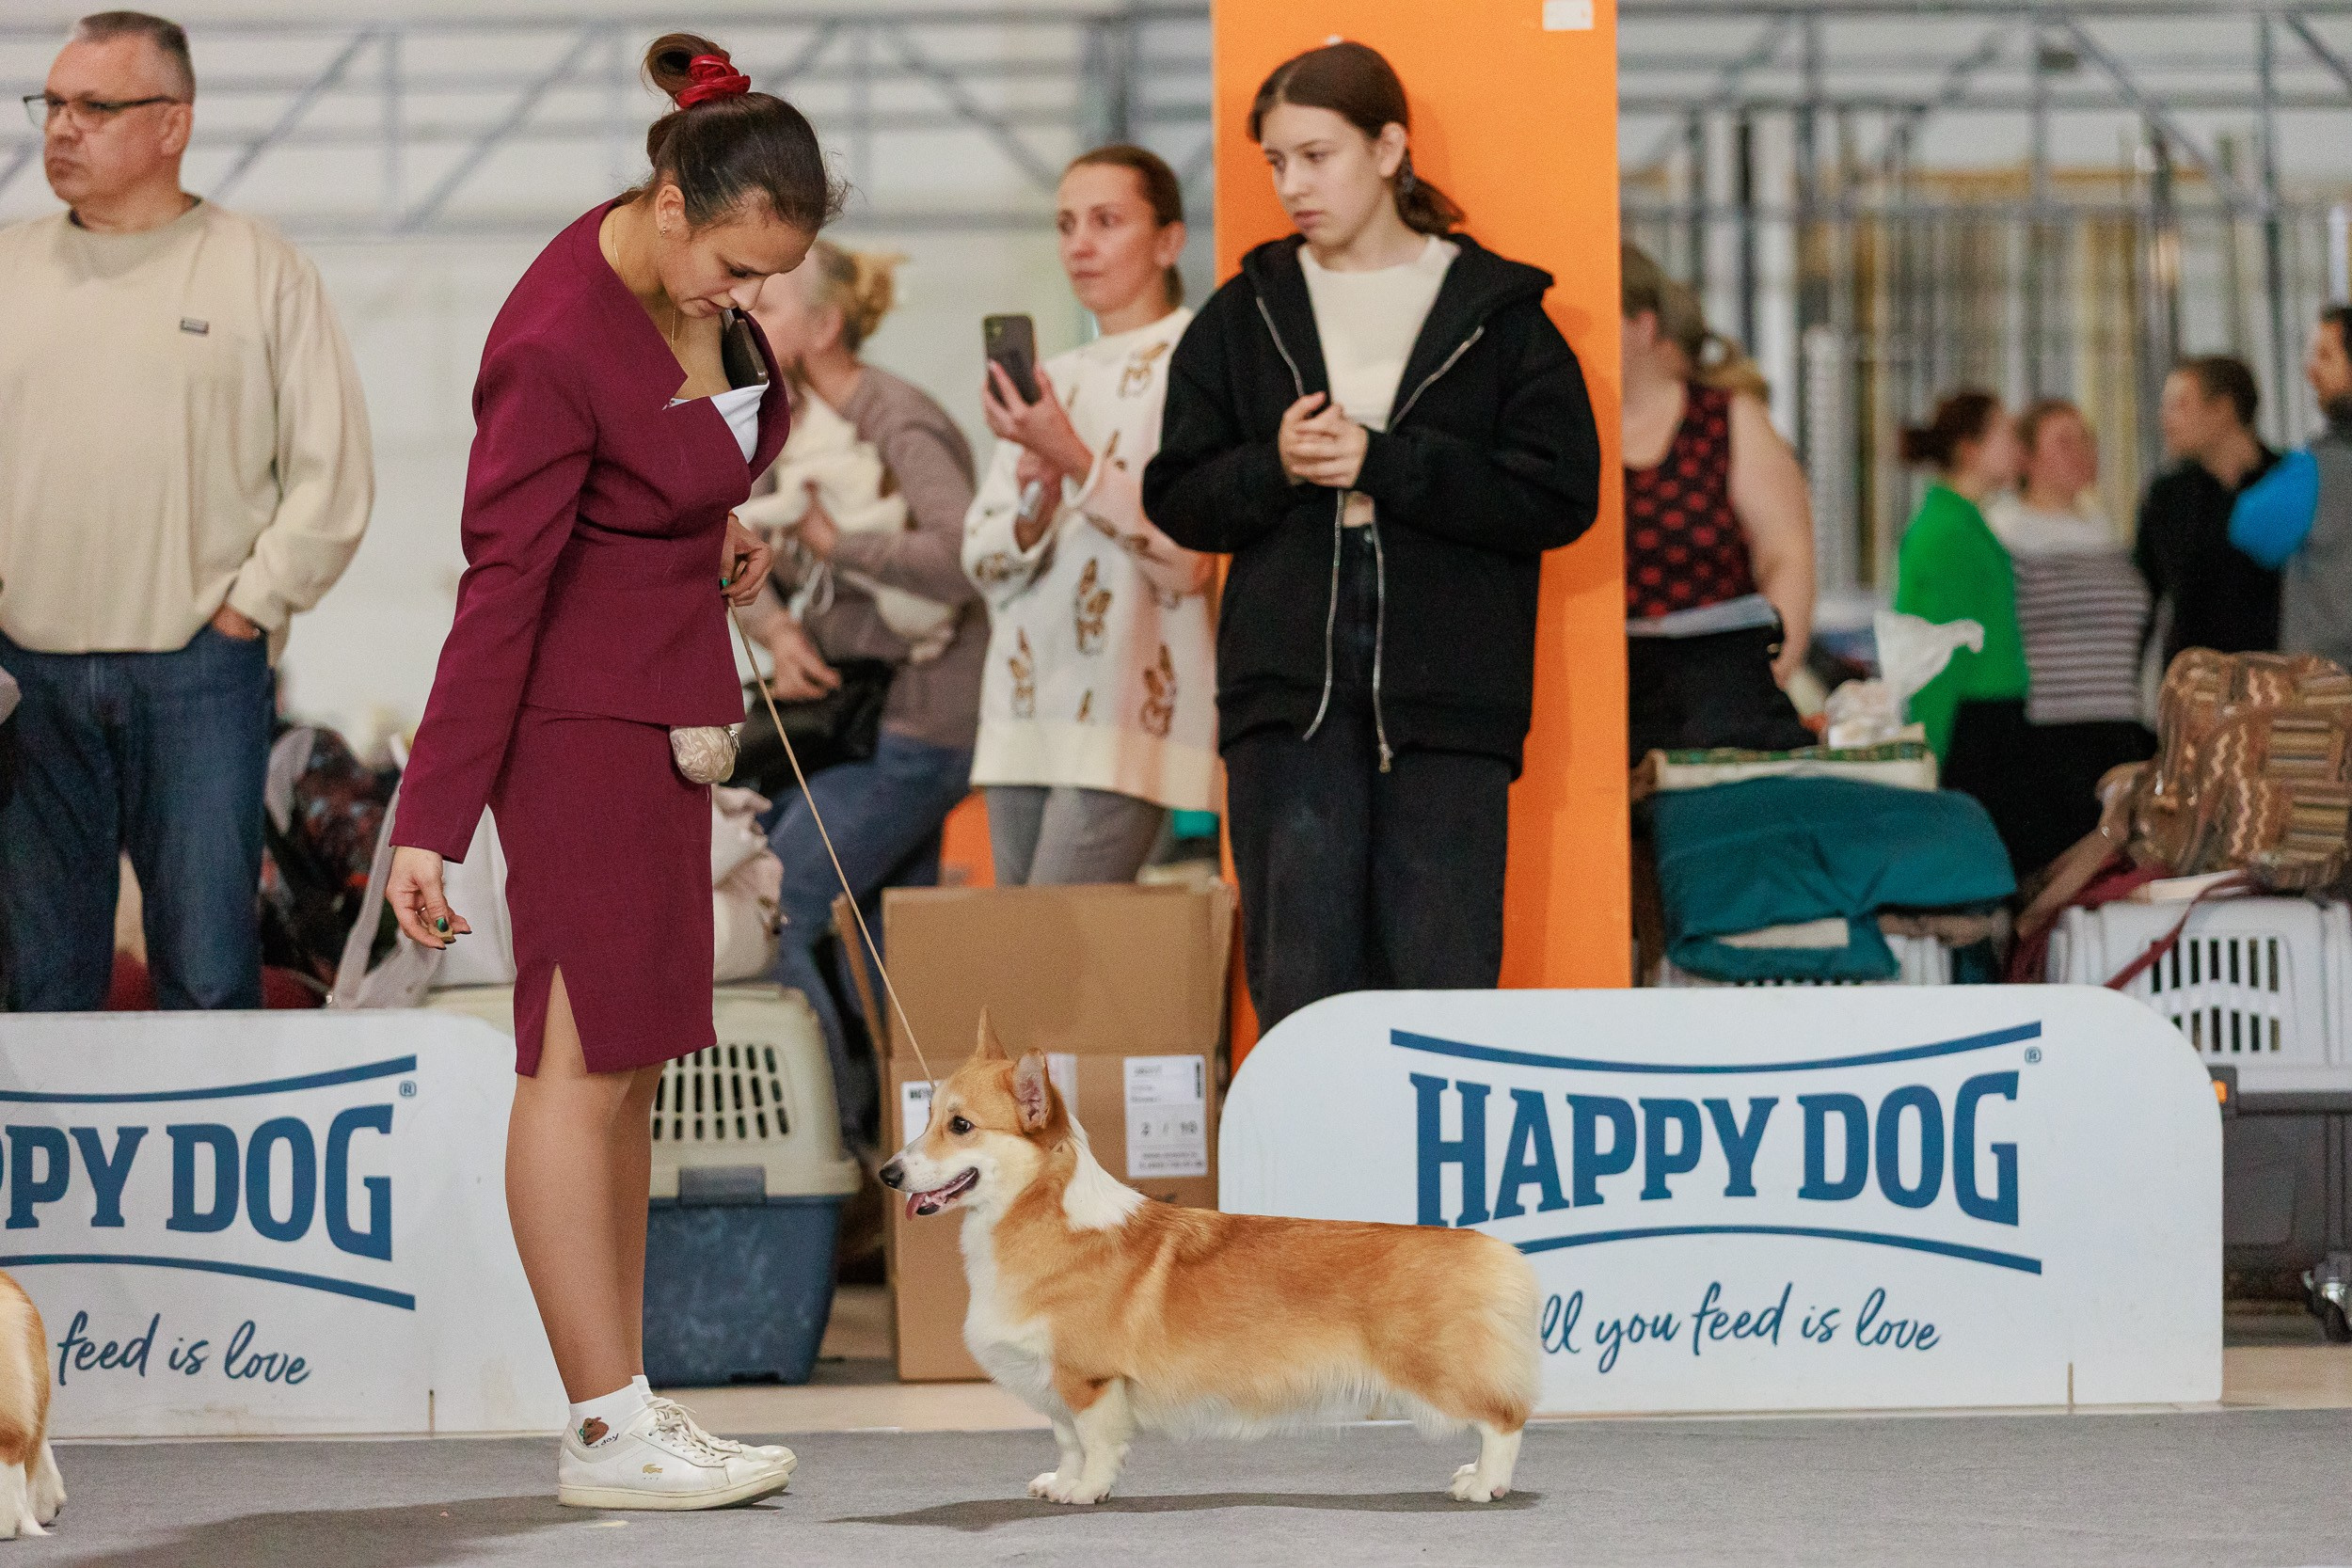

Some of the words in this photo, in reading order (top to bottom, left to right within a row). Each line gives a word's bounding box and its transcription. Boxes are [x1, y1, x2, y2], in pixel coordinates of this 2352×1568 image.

[0, 1124, 149, 1230] PY
[166, 1103, 394, 1261] DOG
[1409, 1071, 1782, 1227] HAPPY
[1796, 1070, 2021, 1228] DOG
[56, 1309, 161, 1386] feed
[167, 1337, 210, 1376] is
[223, 1320, 310, 1386] love
[1540, 1290, 1583, 1354] ll
[1595, 1312, 1681, 1374] you
[1692, 1281, 1792, 1356] feed
[1801, 1306, 1841, 1344] is
[1855, 1288, 1940, 1352] love
